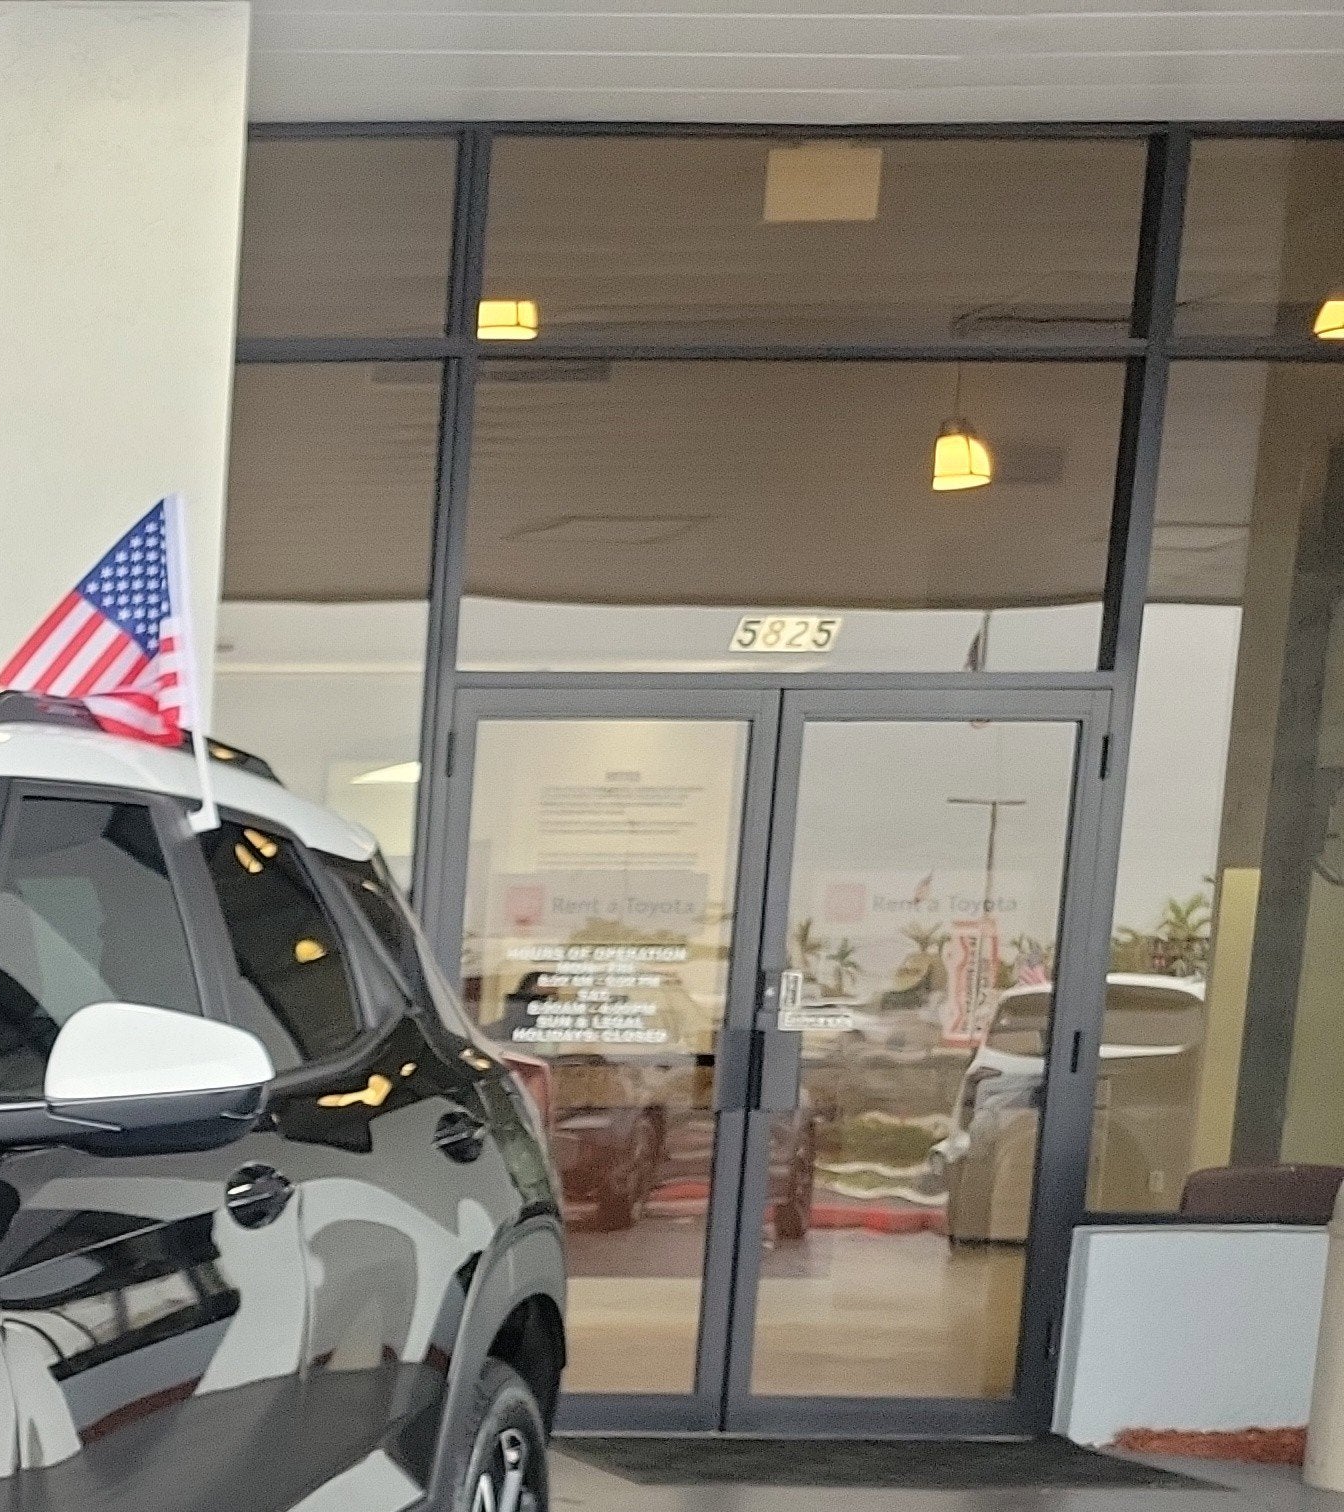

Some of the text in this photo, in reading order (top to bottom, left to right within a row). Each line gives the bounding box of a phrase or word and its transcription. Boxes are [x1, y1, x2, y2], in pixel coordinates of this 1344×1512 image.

[737, 619, 835, 647] 5825
[552, 897, 599, 914] Rent
[627, 897, 695, 918] Toyota
[592, 945, 687, 962] OPERATION
[601, 1028, 669, 1043] CLOSED
